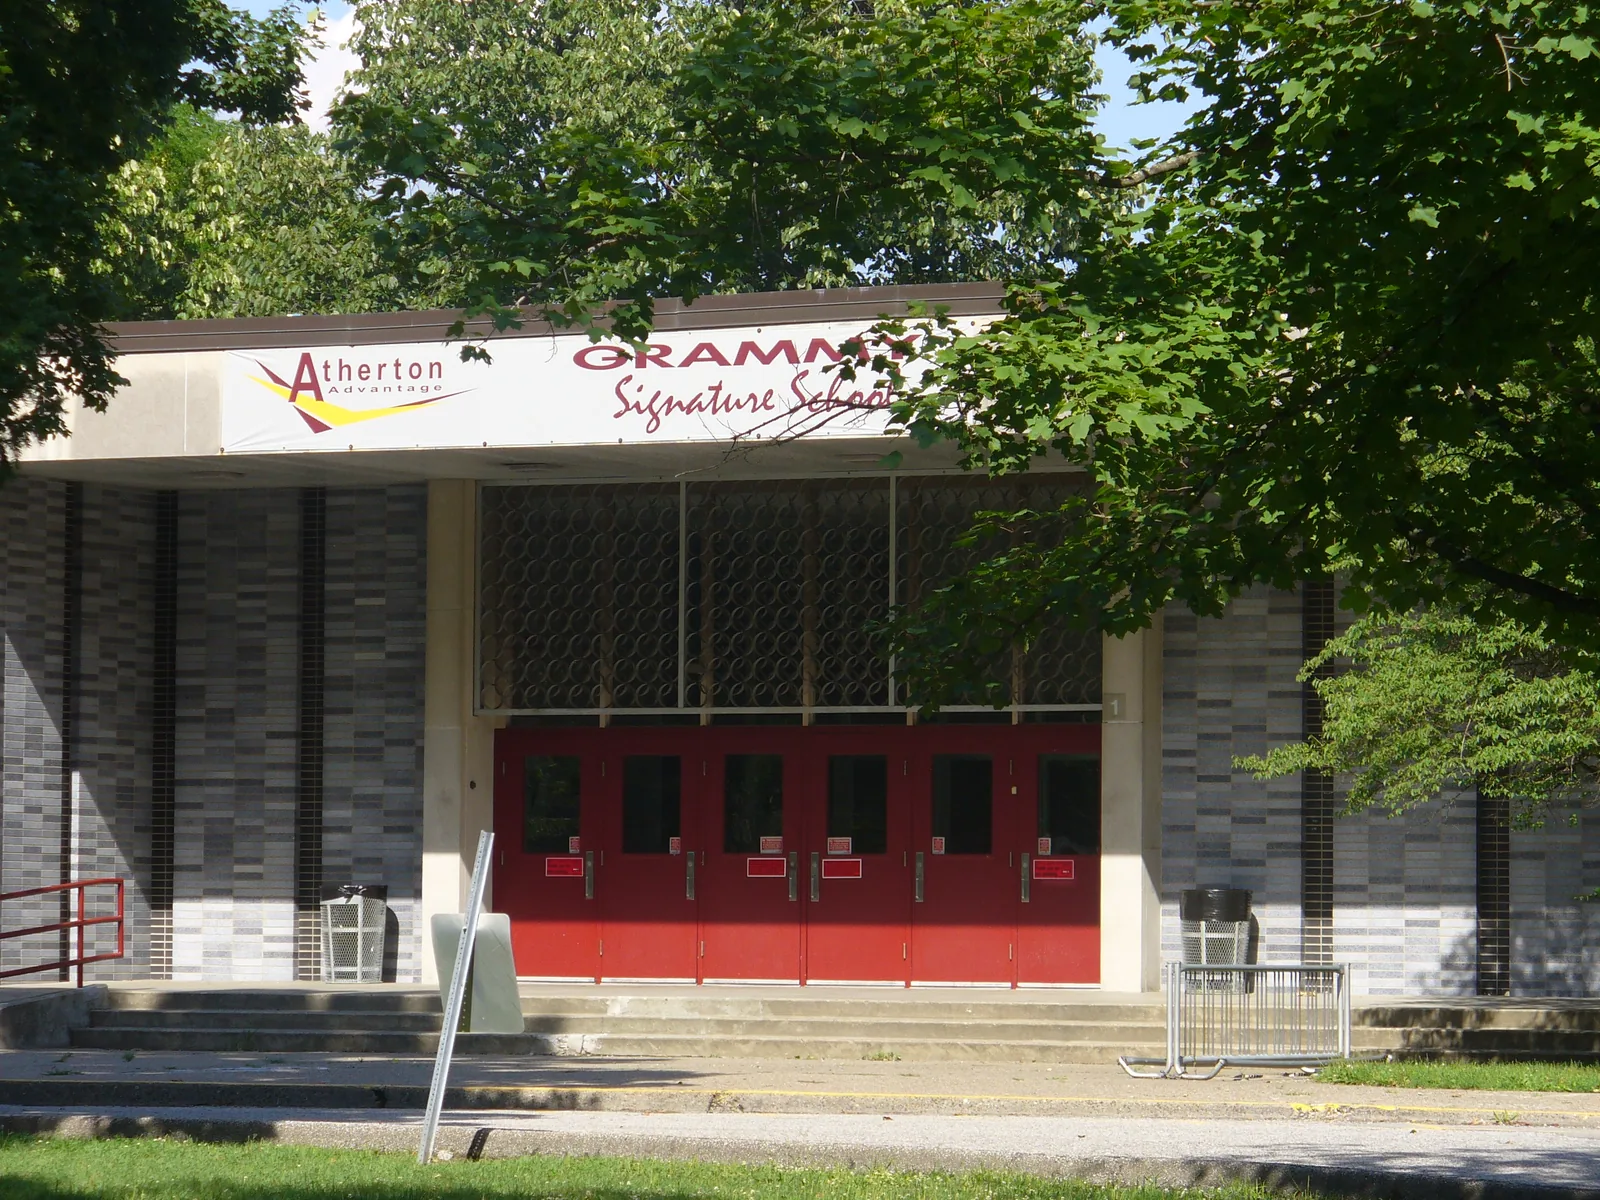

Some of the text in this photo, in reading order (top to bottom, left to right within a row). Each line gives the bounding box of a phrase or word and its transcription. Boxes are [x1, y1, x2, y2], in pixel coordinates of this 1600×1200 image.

[288, 352, 442, 402] Atherton
[328, 384, 442, 394] Advantage
[613, 374, 775, 434] Signature
[1110, 699, 1119, 716] 1
